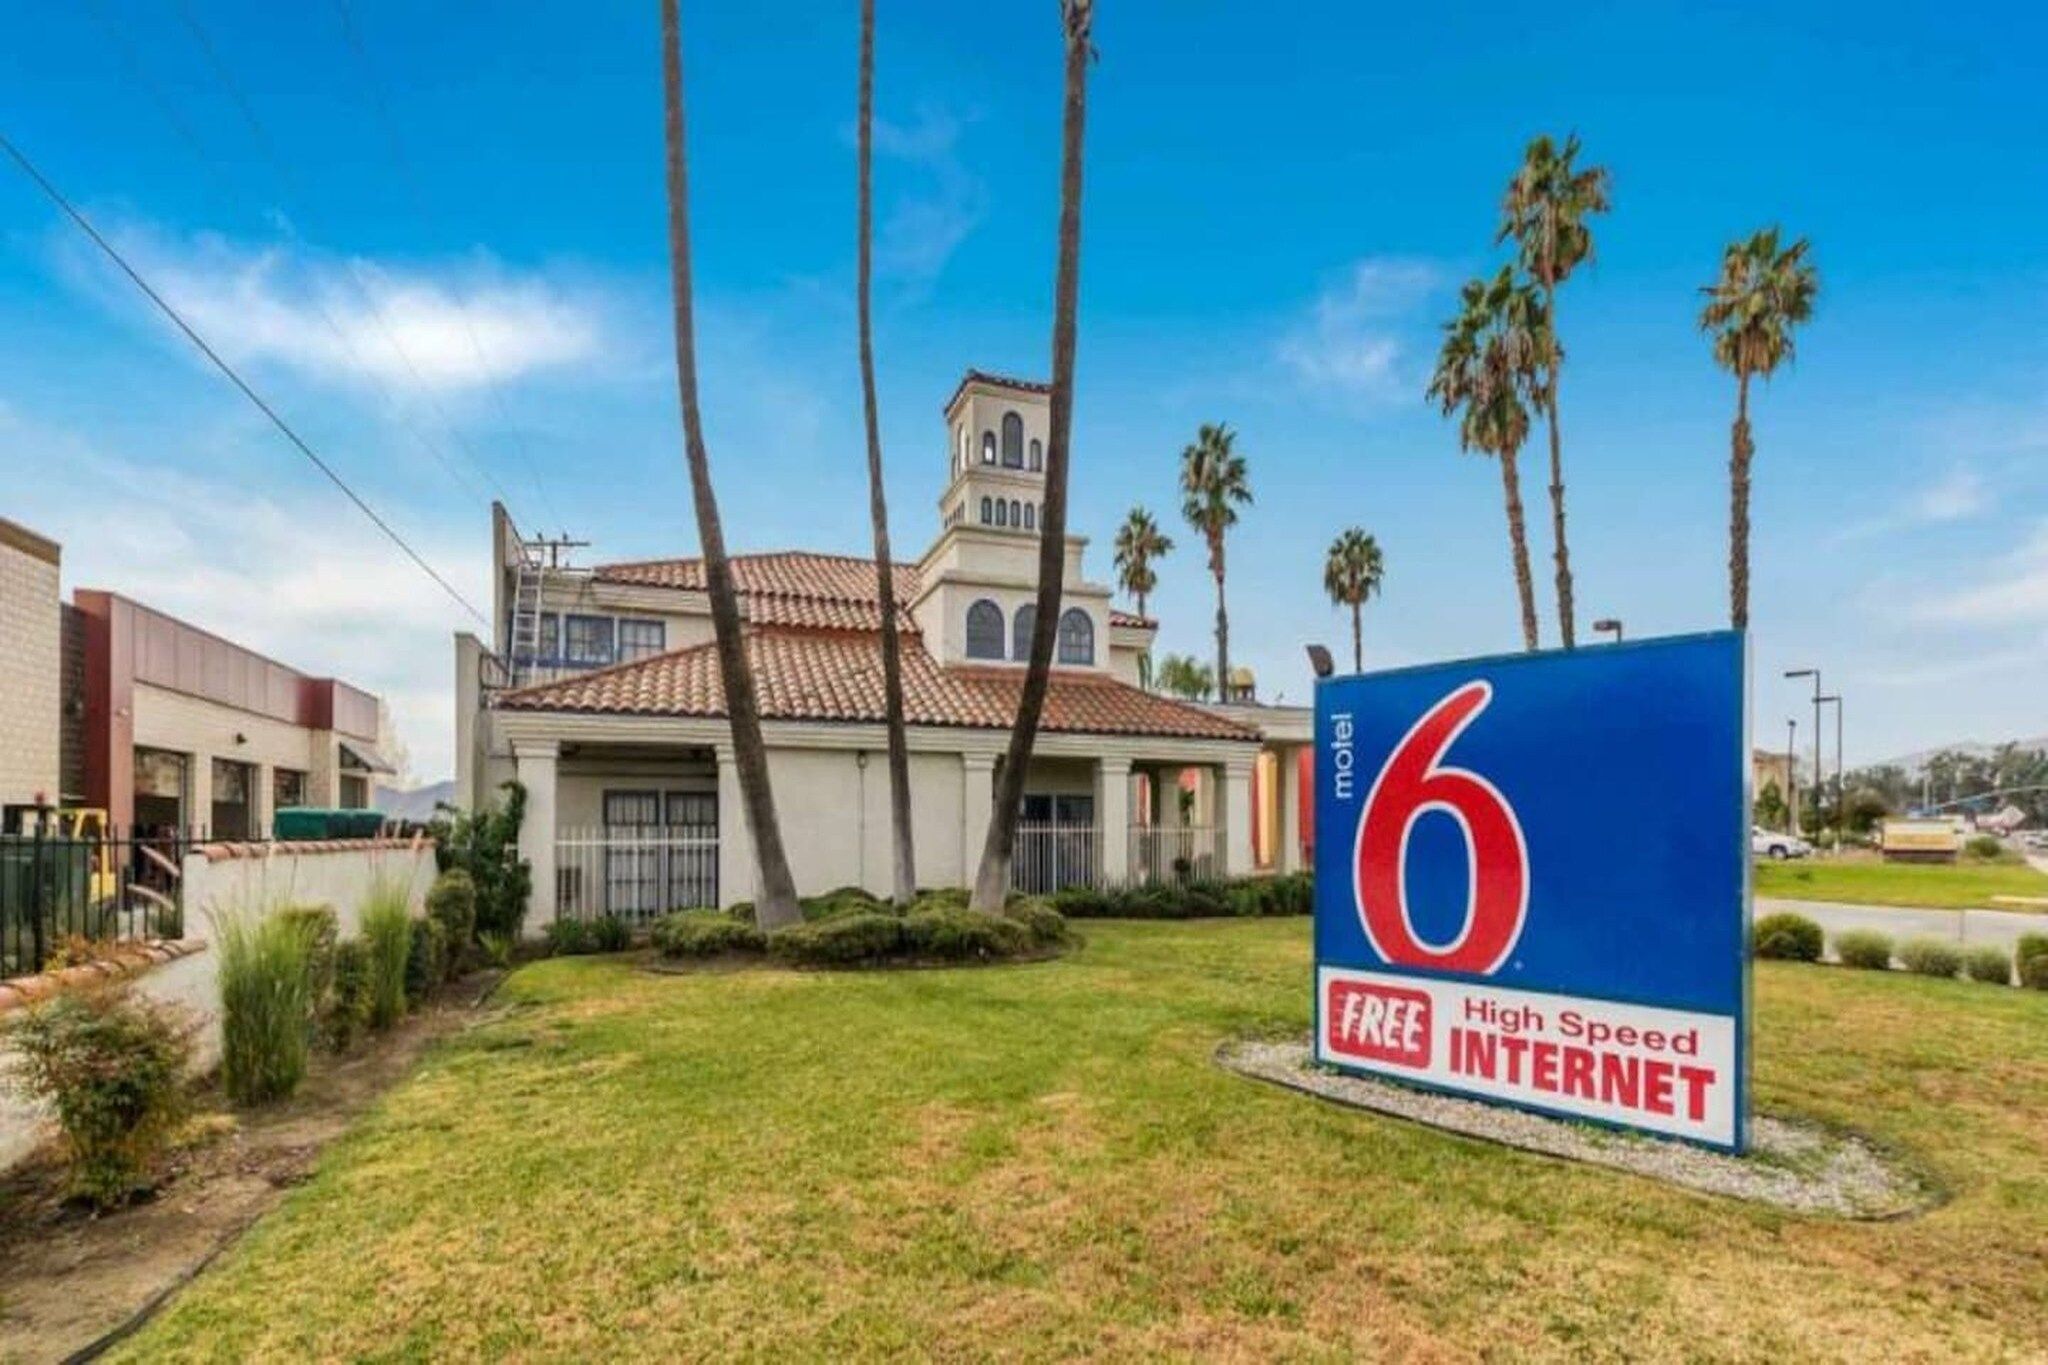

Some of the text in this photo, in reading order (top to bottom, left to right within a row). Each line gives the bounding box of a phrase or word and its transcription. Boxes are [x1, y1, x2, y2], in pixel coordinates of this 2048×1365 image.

[1331, 713, 1353, 799] motel
[1354, 680, 1530, 974] 6
[1339, 991, 1425, 1054] FREE
[1464, 998, 1698, 1056] High Speed
[1451, 1028, 1715, 1121] INTERNET
